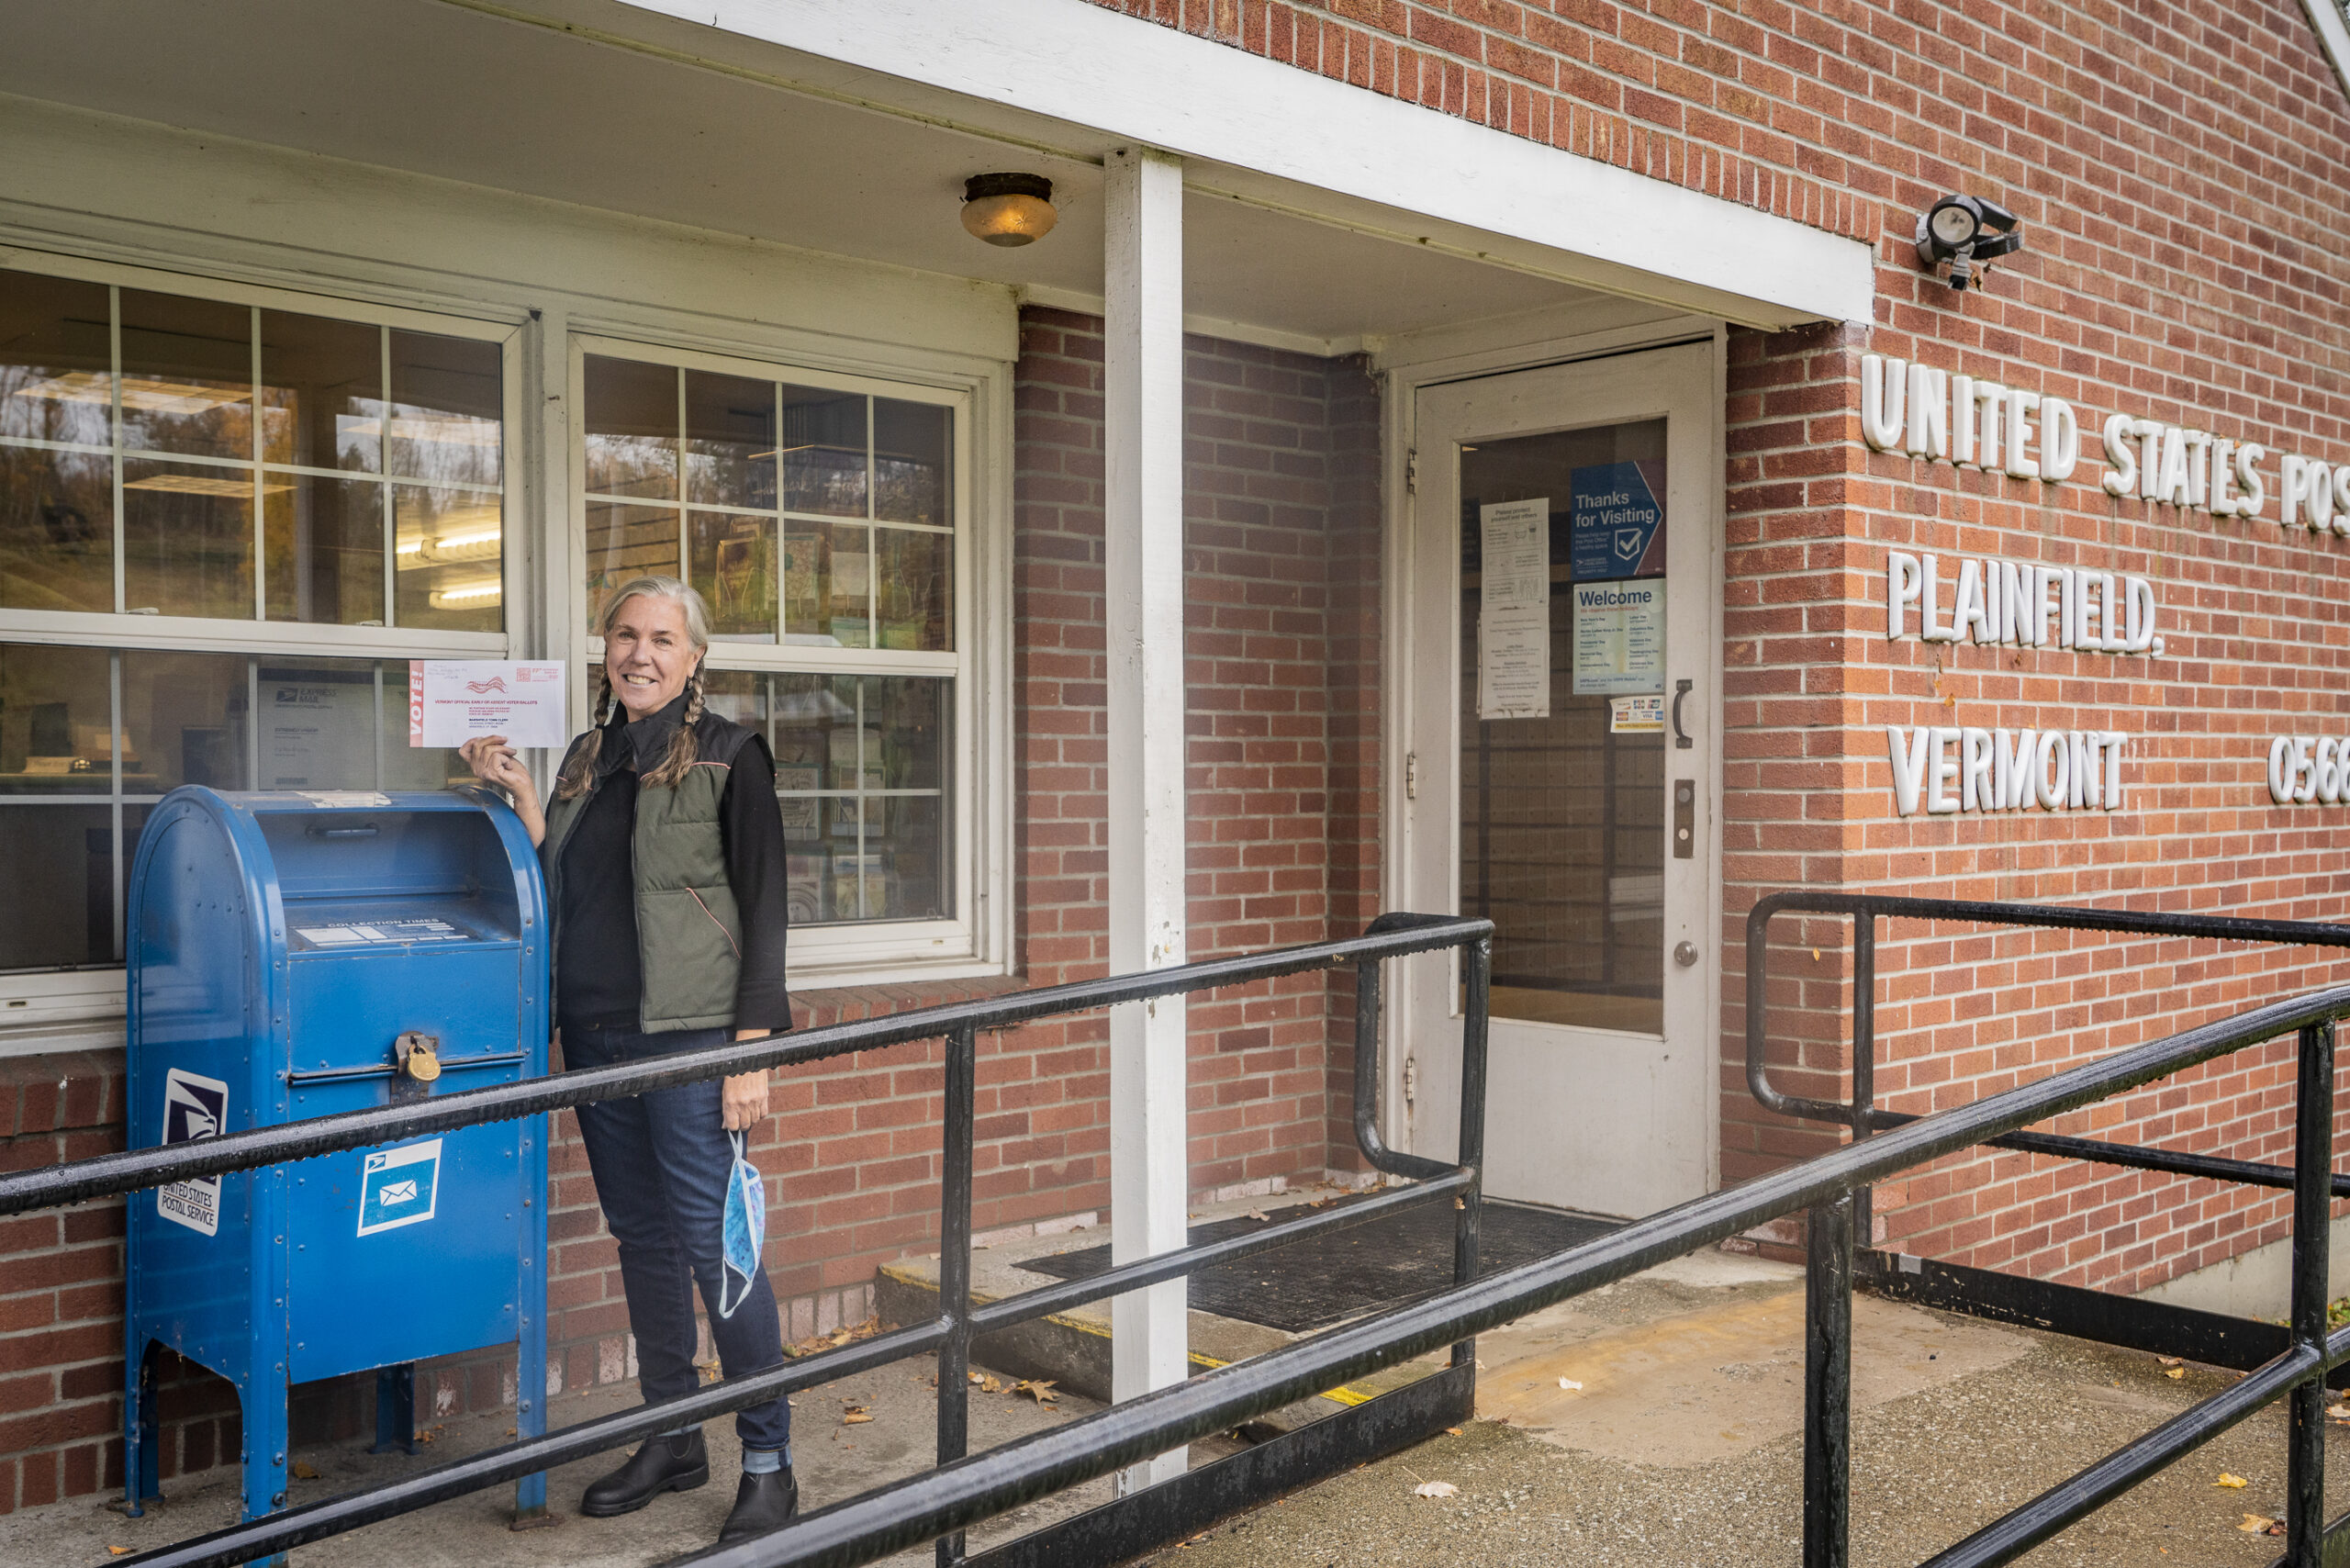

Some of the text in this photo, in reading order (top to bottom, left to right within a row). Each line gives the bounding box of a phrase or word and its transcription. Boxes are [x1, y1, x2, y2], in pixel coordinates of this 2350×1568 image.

[1861, 353, 2350, 534] UNITED STATES POS
[1575, 491, 1629, 510] Thanks
[1575, 507, 1655, 528] for Visiting
[1579, 589, 1652, 607] Welcome
[1887, 551, 2165, 659] PLAINFIELD,
[299, 689, 338, 698] EXPRESS
[299, 696, 319, 704] MAIL
[410, 670, 423, 735] VOTE!
[1886, 725, 2129, 816] VERMONT
[2268, 736, 2350, 803] 0566
[327, 919, 402, 928] COLLECTION
[189, 1187, 212, 1207] STATES
[162, 1195, 215, 1226] POSTAL SERVICE
